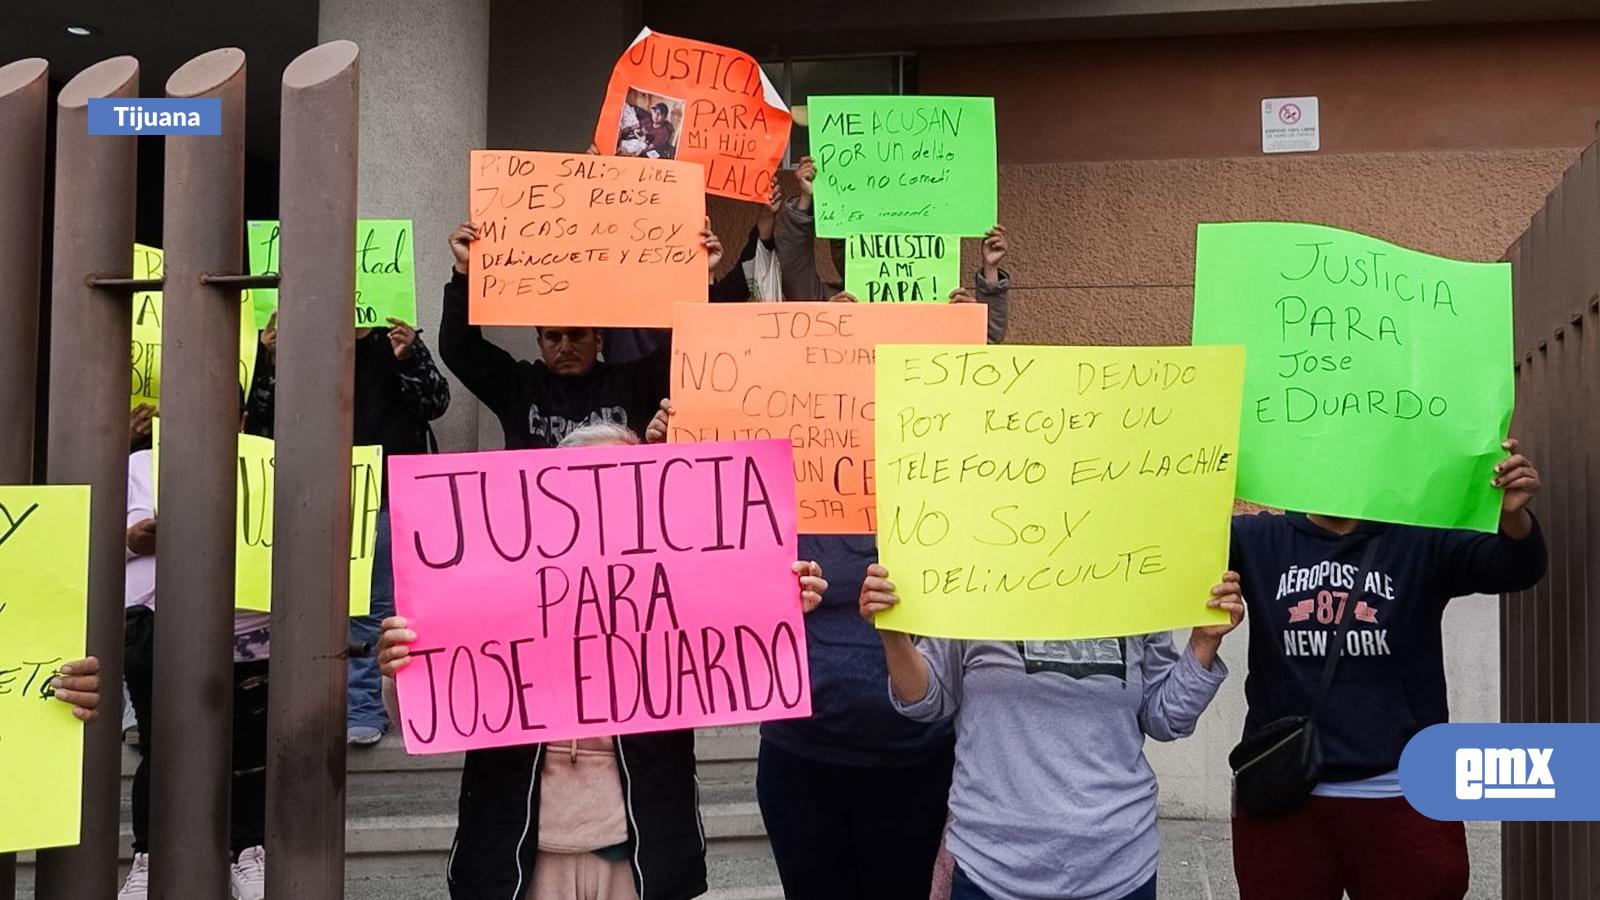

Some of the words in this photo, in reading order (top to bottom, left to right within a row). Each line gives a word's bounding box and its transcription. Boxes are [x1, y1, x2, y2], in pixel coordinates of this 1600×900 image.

[690, 99, 768, 134] PARA
[822, 112, 864, 136] ME
[872, 107, 962, 137] ACUSAN
[819, 143, 866, 173] POR
[476, 184, 566, 217] JUES
[520, 218, 579, 239] CASO
[631, 218, 685, 243] SOY
[619, 250, 632, 260] Y
[639, 245, 699, 265] ESTOY
[879, 262, 891, 277] A
[758, 312, 853, 339] JOSE
[1275, 296, 1402, 345] PARA
[806, 347, 875, 364] EDUA
[904, 352, 1034, 394] ESTOY
[1122, 406, 1172, 428] UN
[790, 424, 860, 448] GRAVE
[414, 457, 783, 570] JUSTICIA
[888, 501, 950, 547] NO
[1276, 561, 1395, 600] AÉROPOSALE
[536, 562, 679, 638] PARA
[1316, 590, 1349, 624] 87
[1283, 630, 1328, 656] NEW
[1333, 630, 1391, 656] ORK
[408, 636, 548, 744] JOSE
[573, 621, 802, 724] EDUARDO
